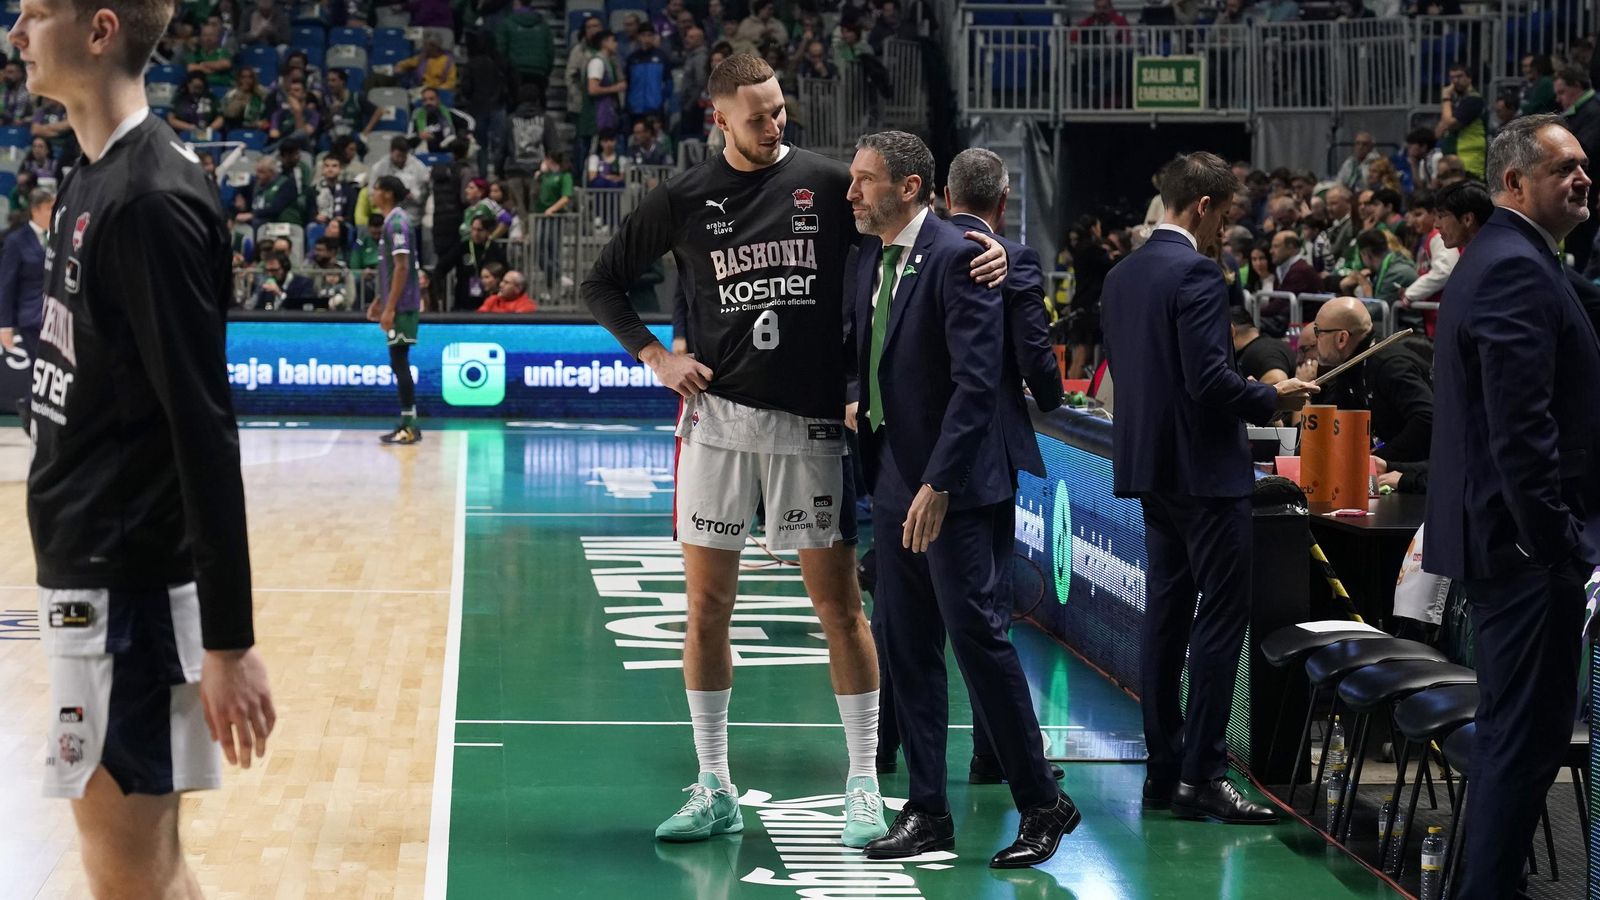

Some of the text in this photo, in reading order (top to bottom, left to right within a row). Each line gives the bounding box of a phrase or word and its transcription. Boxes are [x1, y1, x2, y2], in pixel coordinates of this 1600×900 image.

[1142, 67, 1195, 83] SALIDA DE
[1137, 86, 1200, 102] EMERGENCIA
[710, 239, 818, 281] BASKONIA
[752, 310, 780, 350] 8
[815, 499, 829, 507] acb
[778, 522, 814, 532] HYUNDAI
